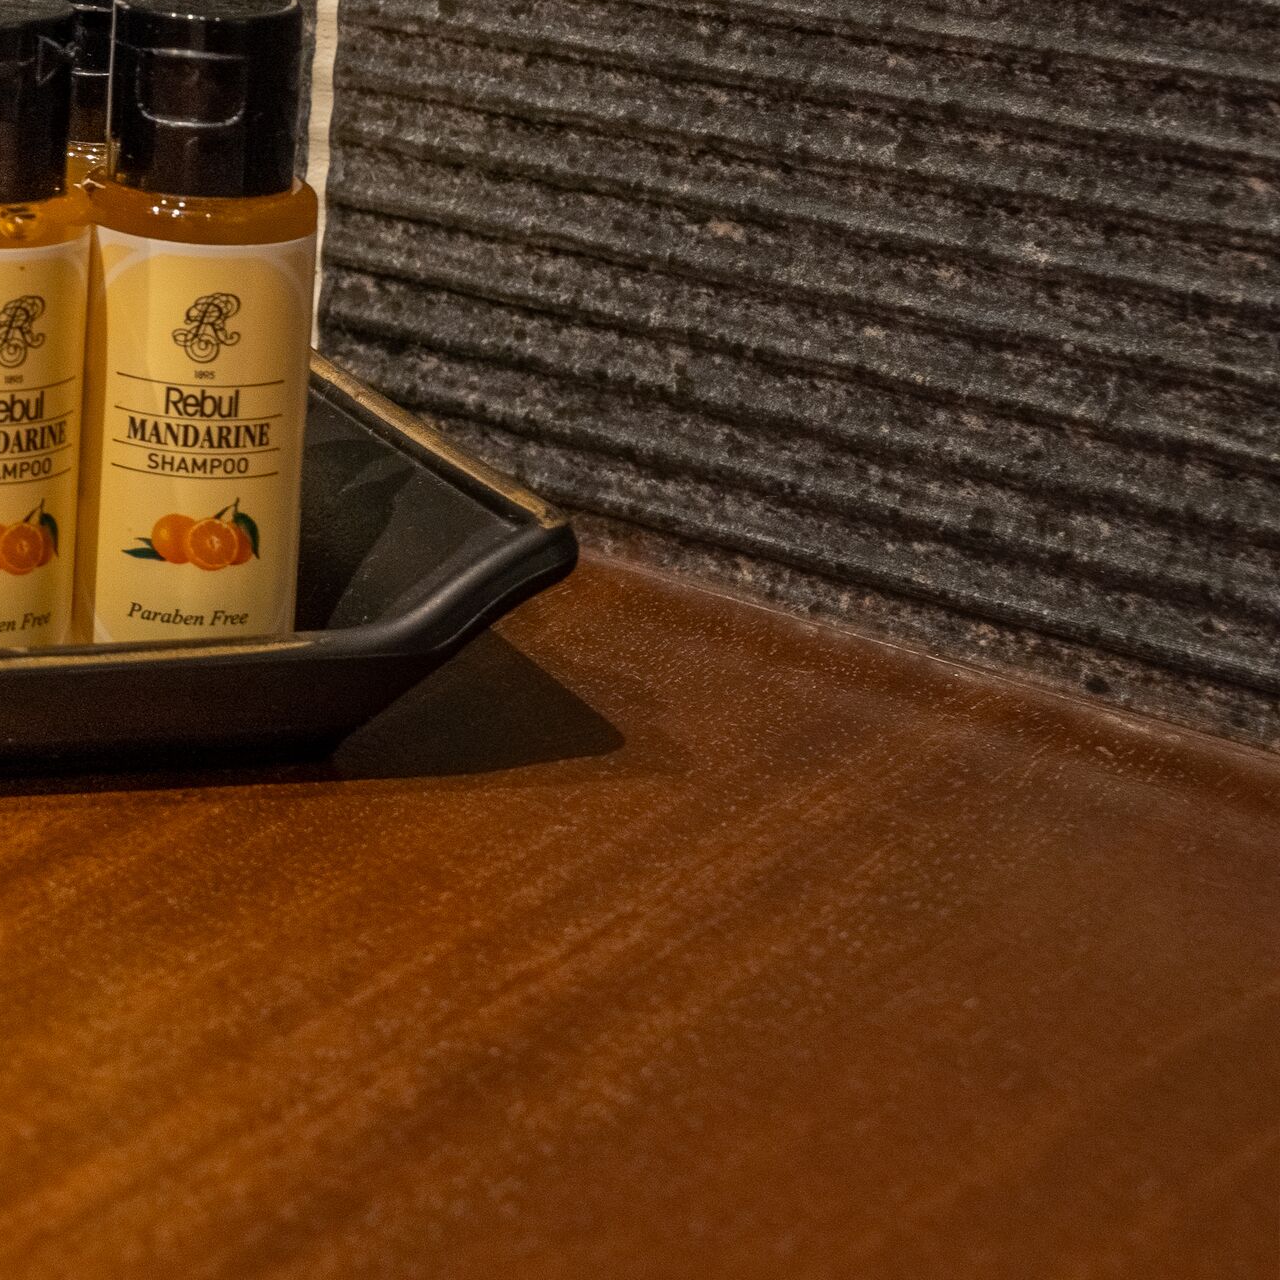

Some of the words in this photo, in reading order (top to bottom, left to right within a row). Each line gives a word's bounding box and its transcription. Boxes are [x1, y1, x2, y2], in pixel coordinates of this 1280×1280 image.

[164, 385, 240, 418] Rebul
[126, 415, 270, 449] MANDARINE
[146, 452, 250, 474] SHAMPOO
[18, 610, 52, 631] Free
[127, 600, 205, 627] Paraben
[208, 609, 249, 627] Free
